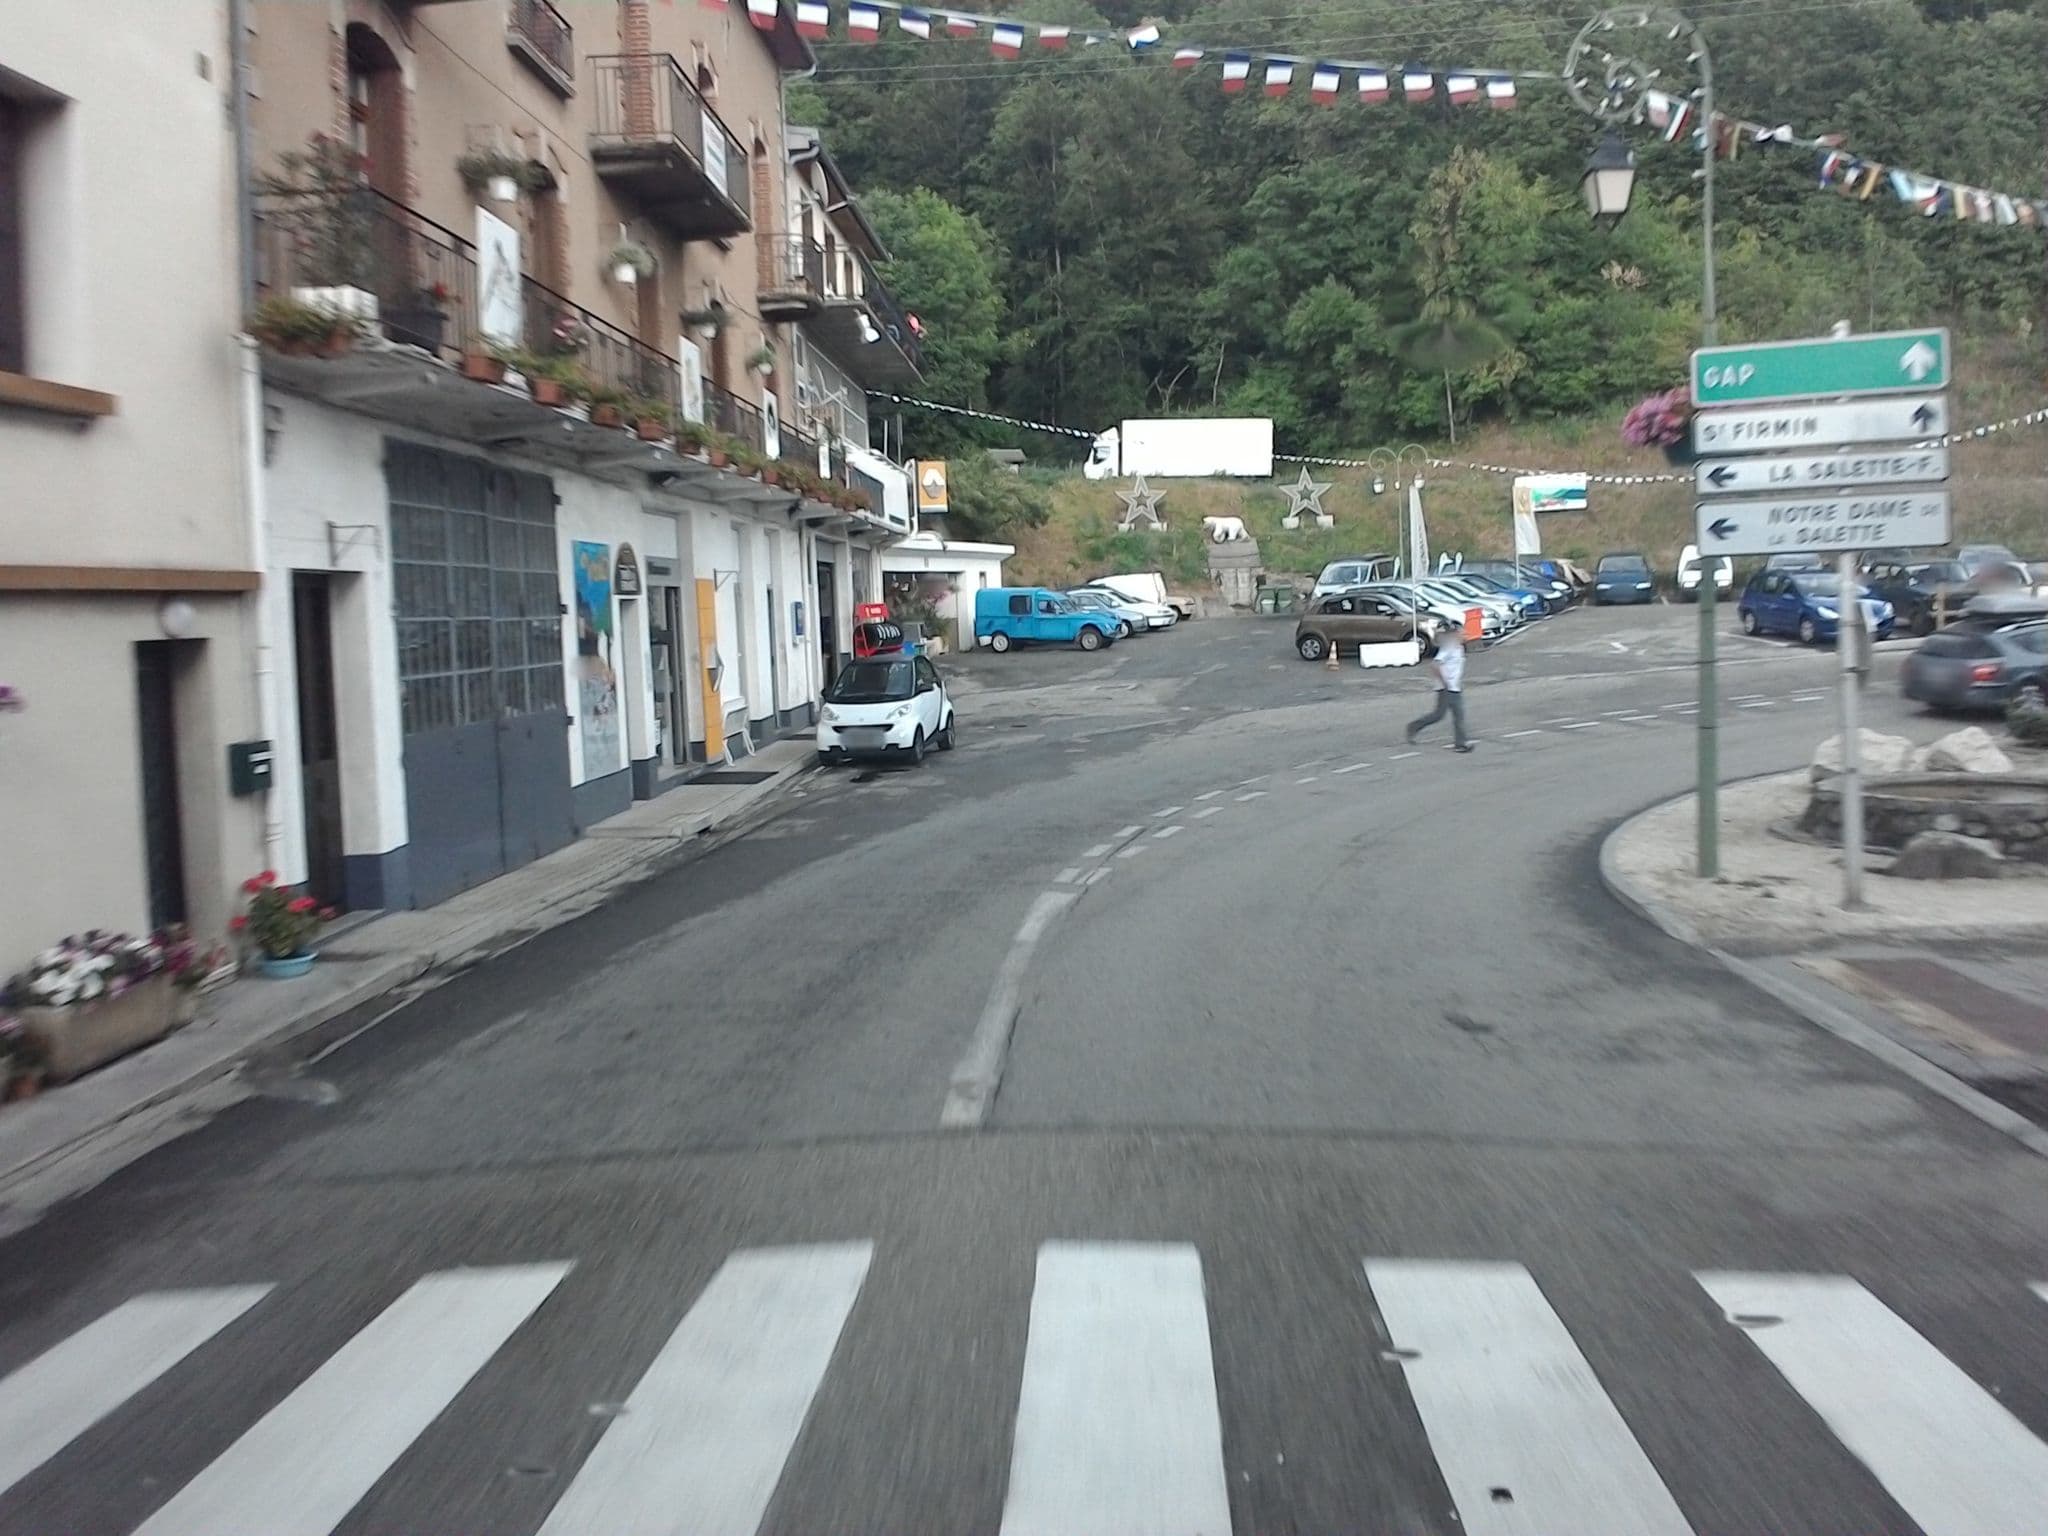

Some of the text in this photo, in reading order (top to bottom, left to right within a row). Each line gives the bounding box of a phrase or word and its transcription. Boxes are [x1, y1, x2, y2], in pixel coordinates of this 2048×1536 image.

[1703, 363, 1755, 389] GAP
[1733, 416, 1818, 440] FIRMIN
[1768, 463, 1794, 483] LA
[1767, 504, 1838, 525] NOTRE
[1848, 499, 1912, 521] DAME
[1795, 523, 1888, 545] SALETTE
